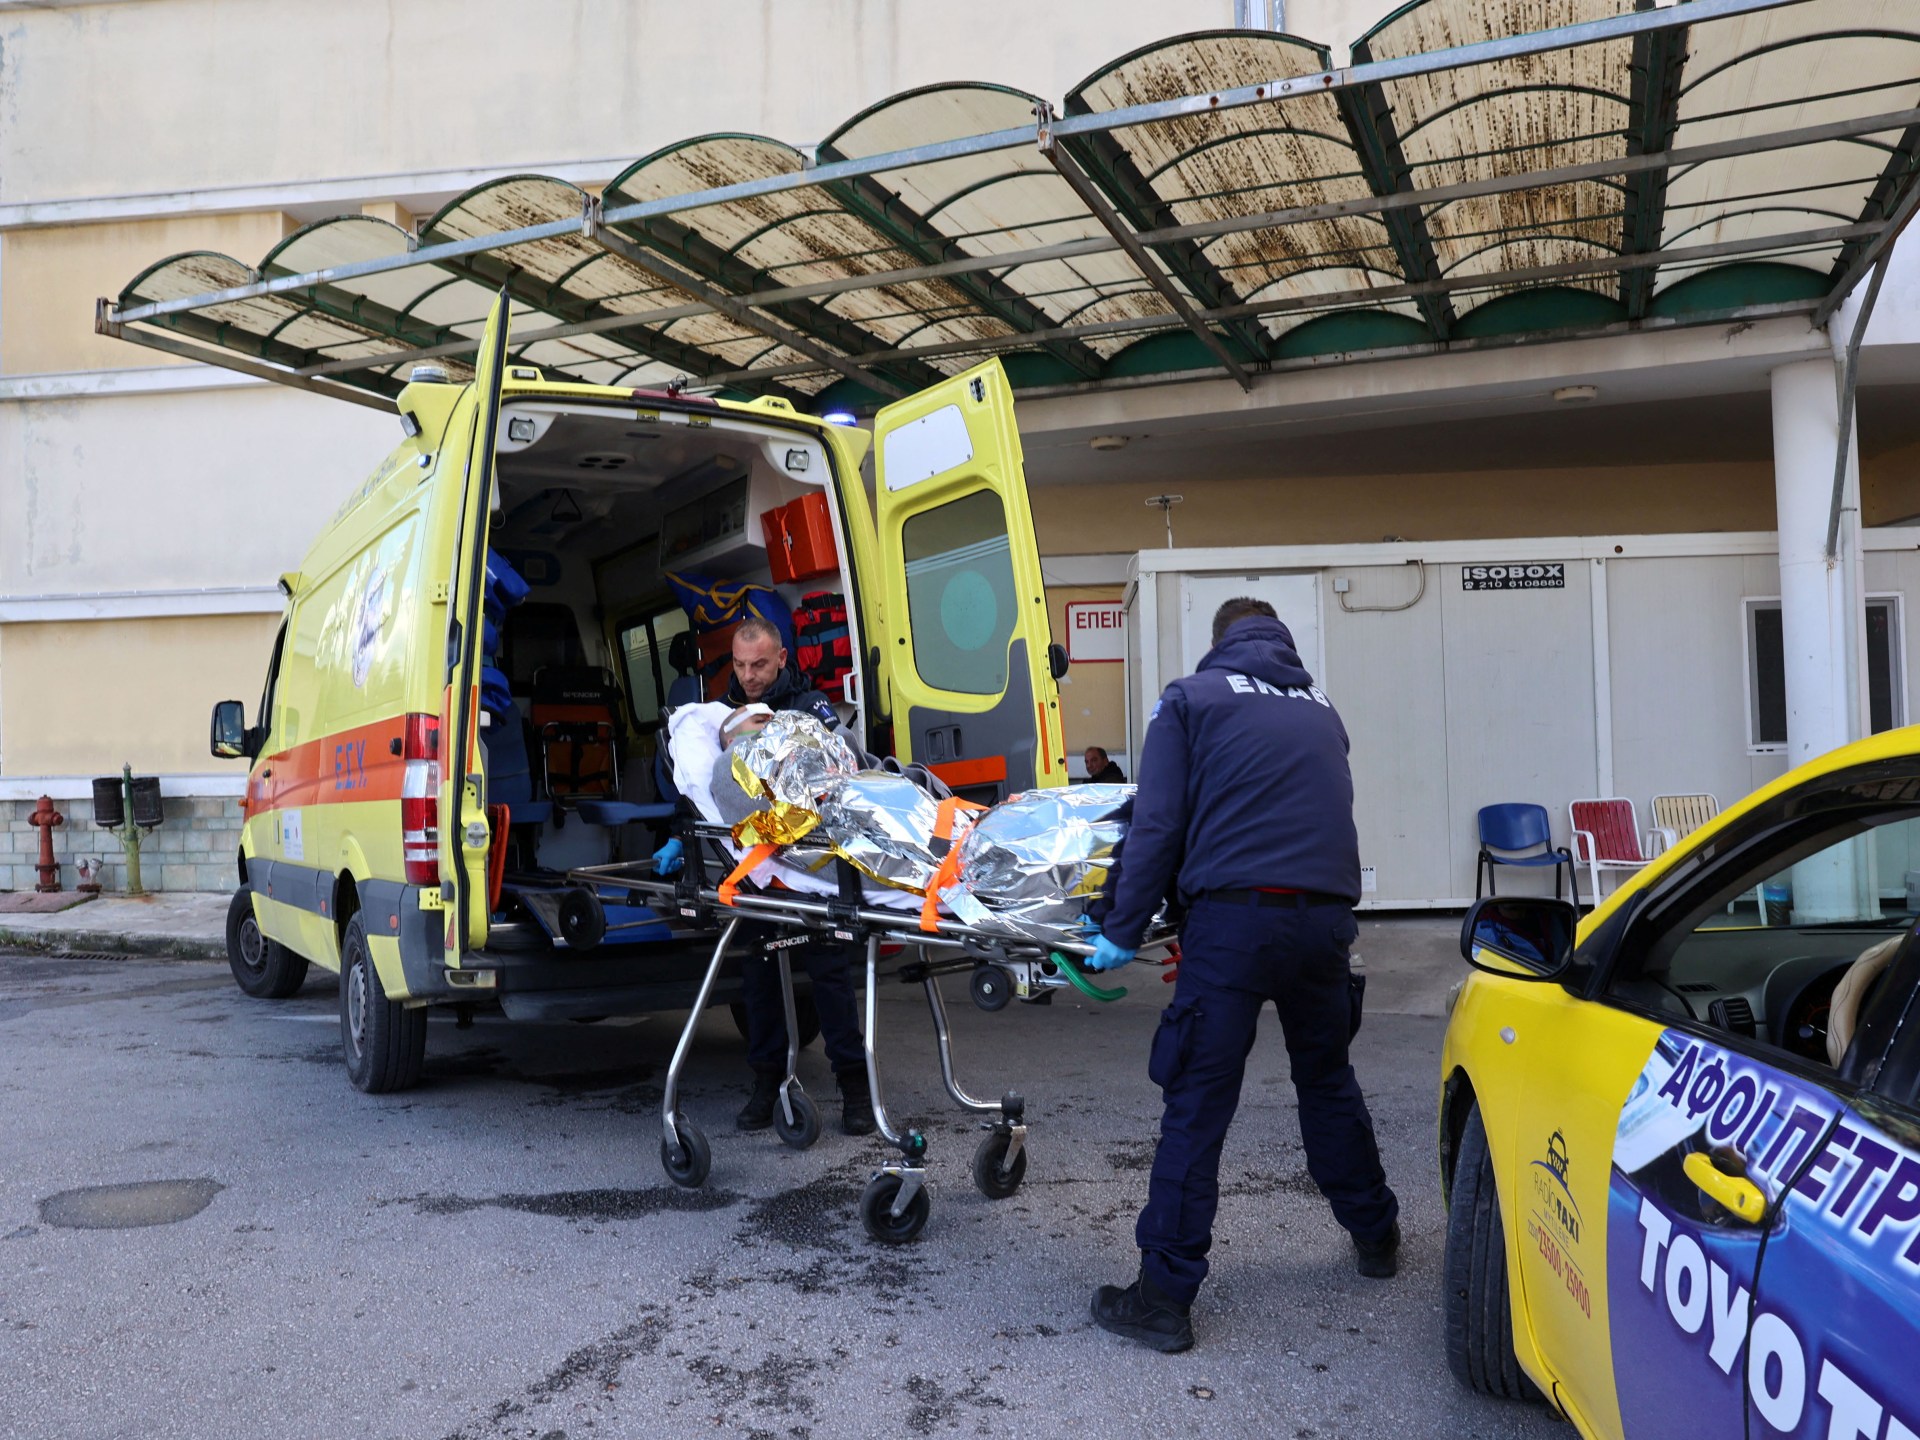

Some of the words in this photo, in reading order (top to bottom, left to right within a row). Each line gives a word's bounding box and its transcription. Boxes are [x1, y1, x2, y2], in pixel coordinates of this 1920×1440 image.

[1463, 565, 1562, 580] ISOBOX
[1479, 581, 1502, 589] 210
[1509, 580, 1563, 588] 6108880
[802, 836, 830, 844] SPENCE
[766, 935, 809, 950] SPENCER
[1657, 1044, 1776, 1152] ΑΦΟΙ
[1758, 1104, 1920, 1266] ΠΕΤΡ
[1639, 1197, 1920, 1440] TOYOT
